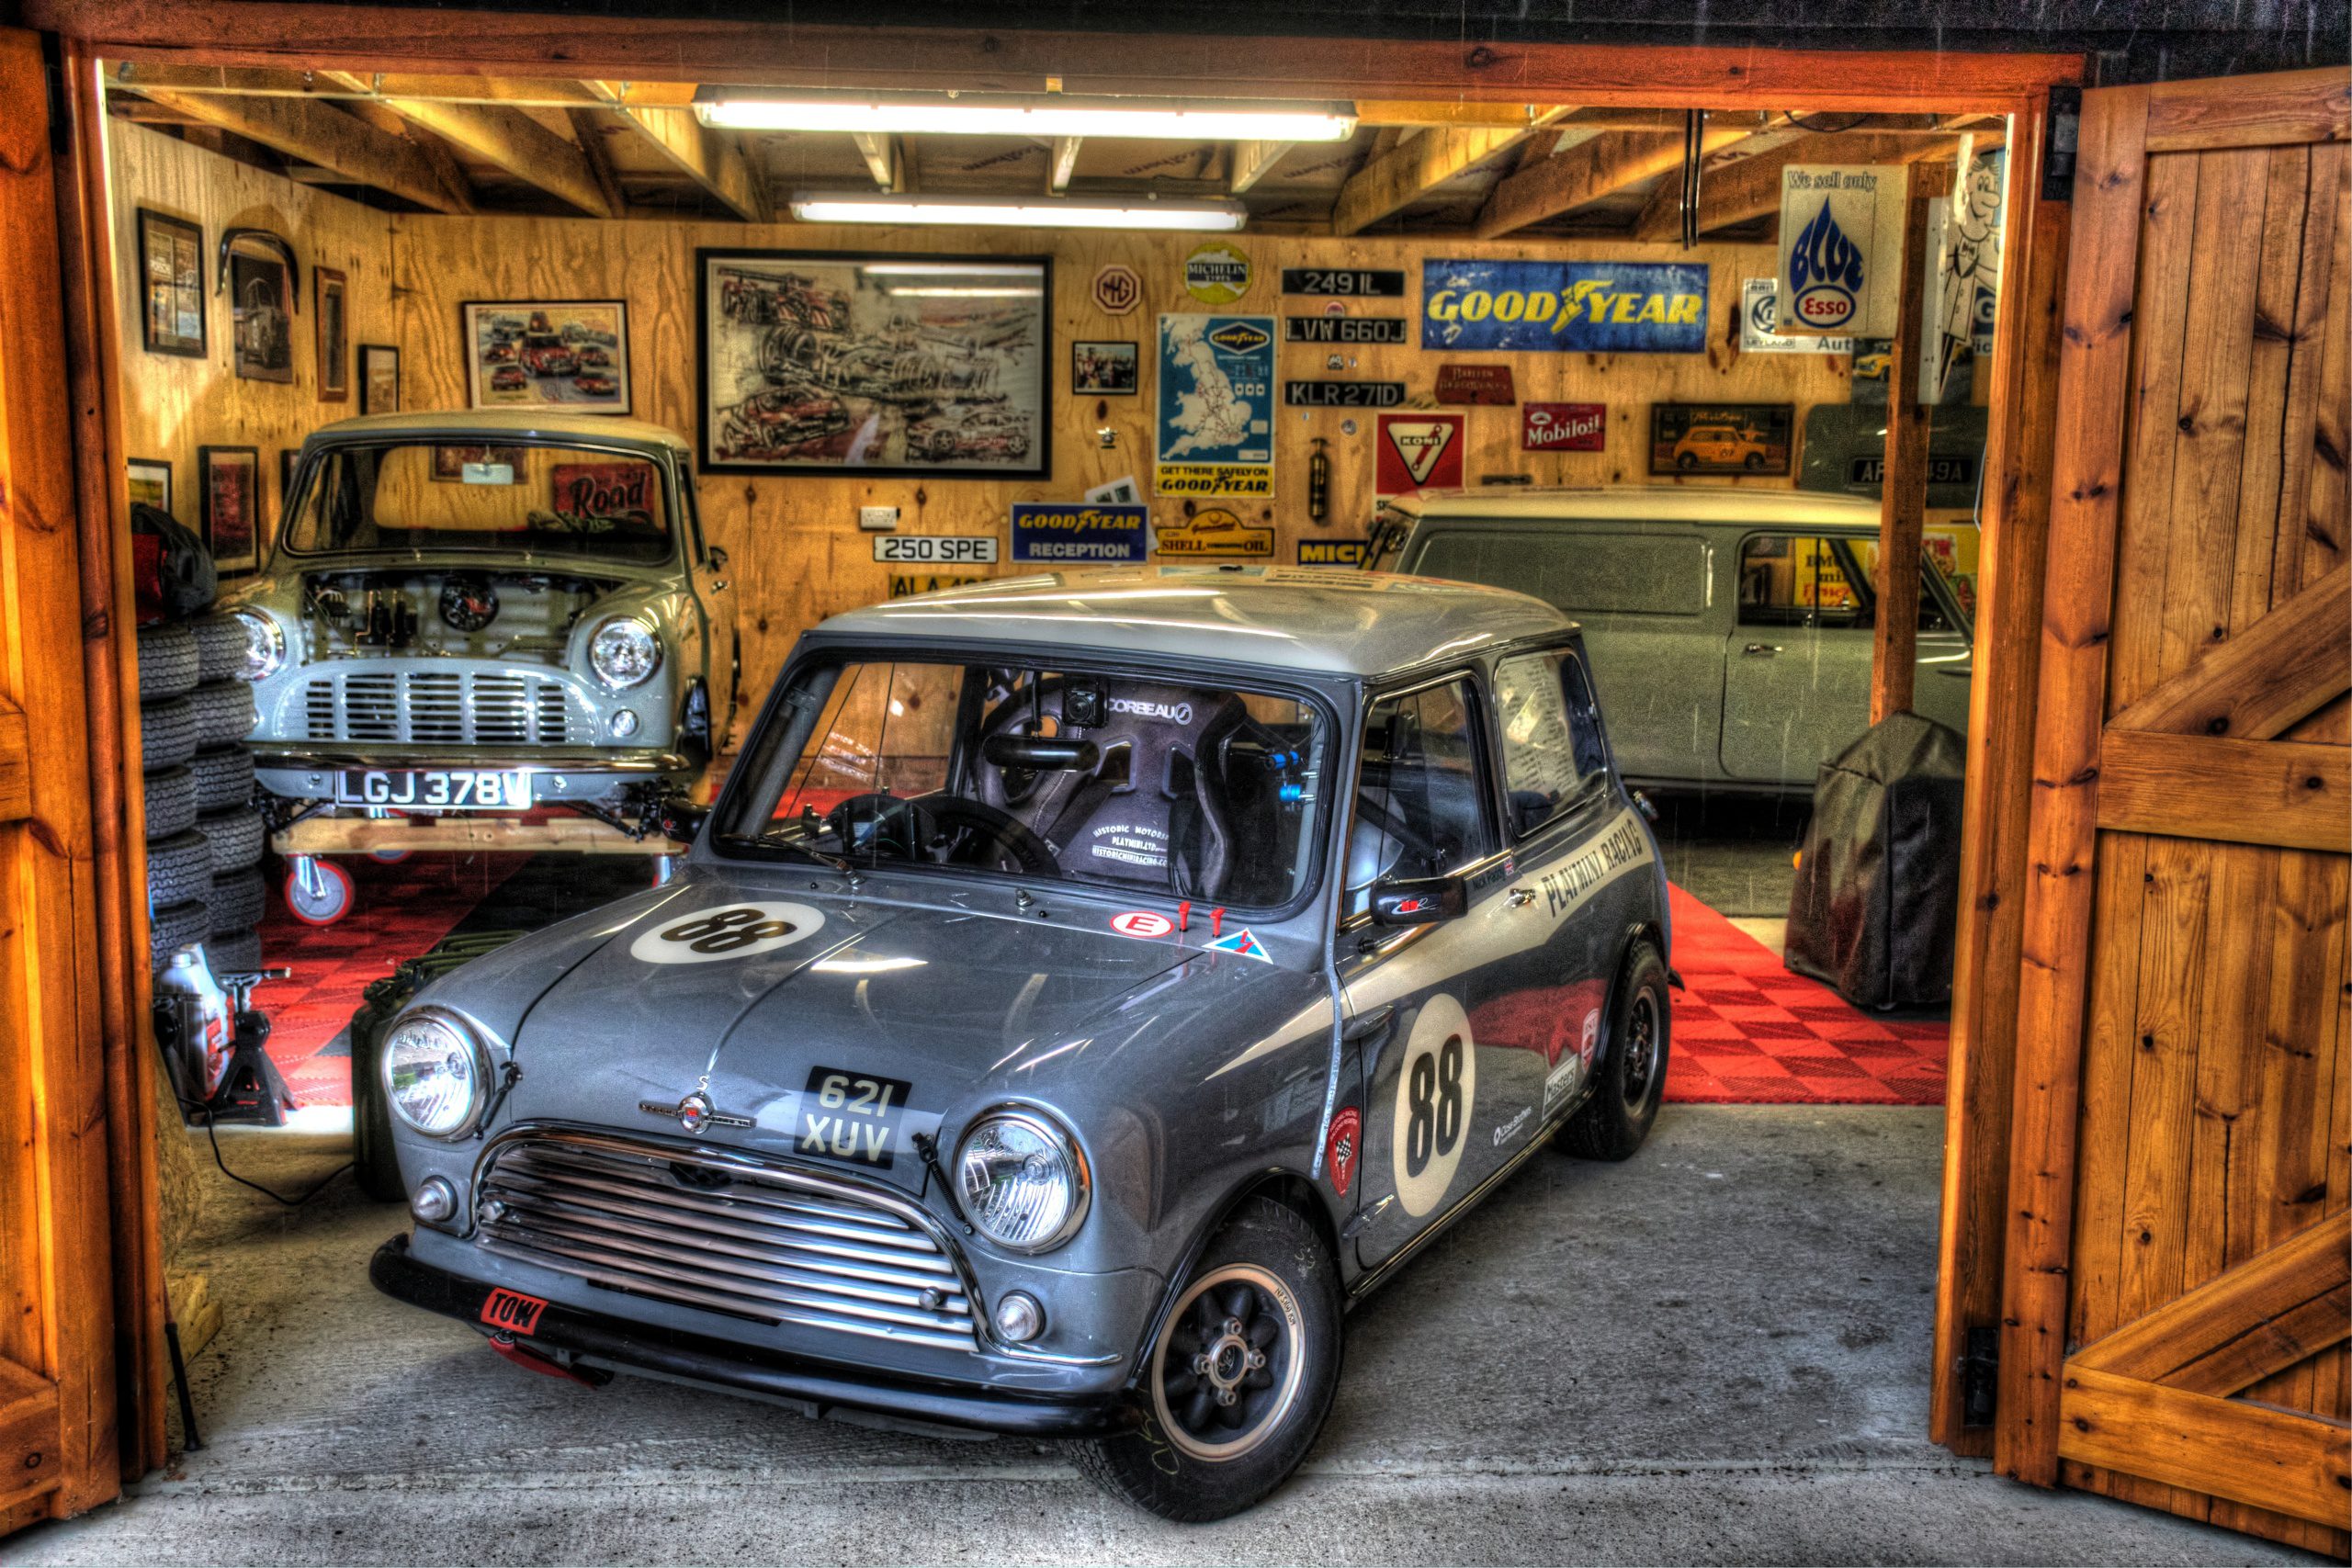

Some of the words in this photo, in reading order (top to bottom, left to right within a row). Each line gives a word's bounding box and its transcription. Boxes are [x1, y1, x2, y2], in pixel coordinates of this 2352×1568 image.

[1787, 171, 1812, 189] We
[1814, 171, 1841, 189] sell
[1843, 172, 1877, 192] only
[1790, 194, 1865, 294] BLUE
[1187, 263, 1247, 276] MICHELIN
[1102, 275, 1130, 303] MG
[1303, 272, 1353, 294] 249
[1286, 319, 1335, 341] LVW
[1747, 339, 1793, 347] LEYLAND
[1291, 382, 1340, 405] KLR
[1343, 384, 1398, 406] 271D
[1527, 413, 1600, 446] Mobiloil
[1401, 436, 1440, 446] KONI
[1160, 467, 1181, 476] GET
[1182, 467, 1214, 476] THERE
[1216, 467, 1252, 477] SAFELY
[1253, 468, 1269, 477] ON
[569, 471, 647, 519] Road
[884, 538, 933, 559] 250
[940, 539, 989, 560] SPE
[1029, 542, 1131, 558] RECEPTION
[1161, 539, 1206, 552] SHELL
[1244, 539, 1269, 552] OIL
[1104, 697, 1176, 719] CORBEAU
[338, 770, 415, 804] LGJ
[1092, 824, 1130, 838] HISTORIC
[1541, 851, 1604, 918] PLAYMINI
[1600, 818, 1644, 872] RACING
[660, 908, 798, 954] 88
[1125, 915, 1159, 933] E
[696, 1074, 710, 1091] S
[819, 1075, 895, 1118] 621
[1406, 1032, 1464, 1179] 88
[801, 1113, 890, 1162] XUV
[489, 1292, 542, 1328] TOW
